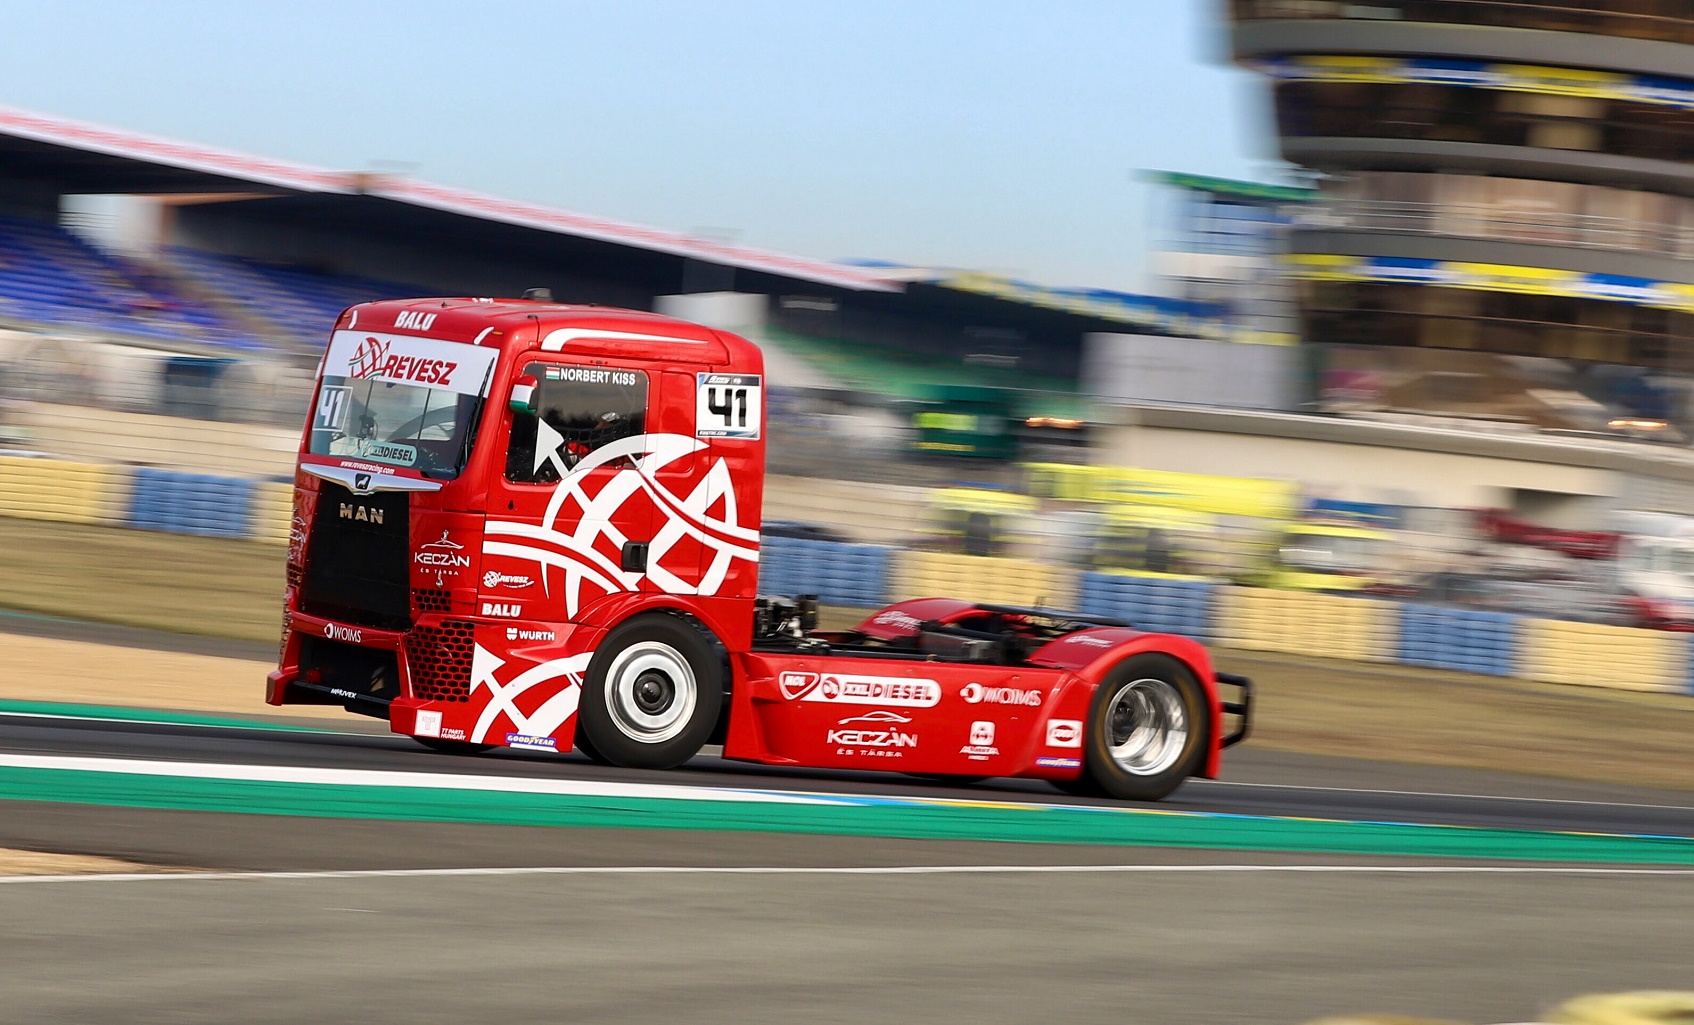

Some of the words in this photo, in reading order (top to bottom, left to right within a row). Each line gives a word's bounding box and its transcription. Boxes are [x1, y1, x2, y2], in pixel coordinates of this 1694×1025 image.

[393, 310, 438, 331] BALU
[560, 368, 610, 384] NORBERT
[612, 371, 636, 386] KISS
[320, 389, 345, 427] 41
[708, 387, 747, 427] 41
[339, 502, 384, 525] MAN
[481, 602, 521, 617] BALU
[870, 682, 934, 701] DIESEL
[440, 732, 467, 741] HUNGARY
[448, 728, 465, 736] PARTS
[507, 734, 555, 747] GOODYEAR
